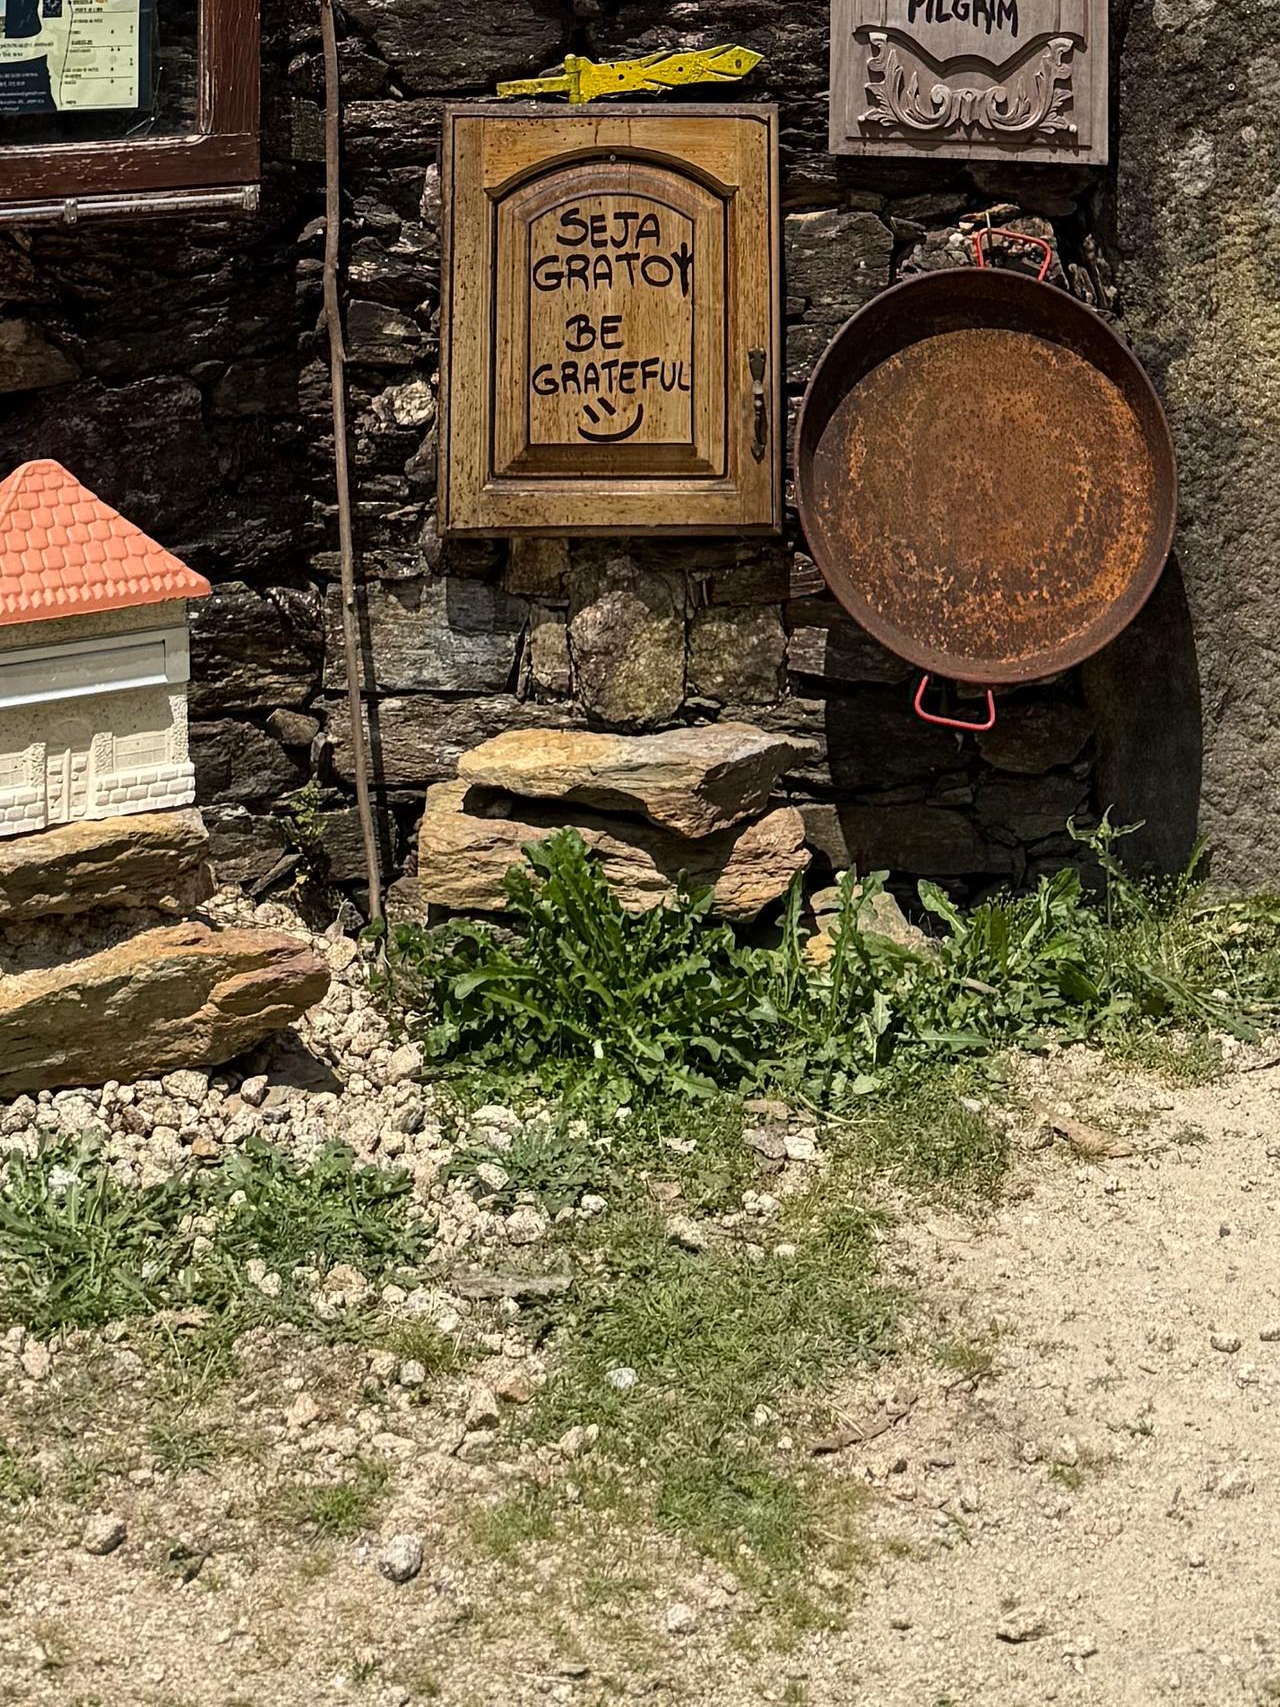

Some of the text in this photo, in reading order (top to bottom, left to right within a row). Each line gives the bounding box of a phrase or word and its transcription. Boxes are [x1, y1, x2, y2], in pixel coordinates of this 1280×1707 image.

[555, 207, 660, 249] SEJA
[565, 314, 624, 353] BE
[531, 357, 691, 396] GRATEFUL
